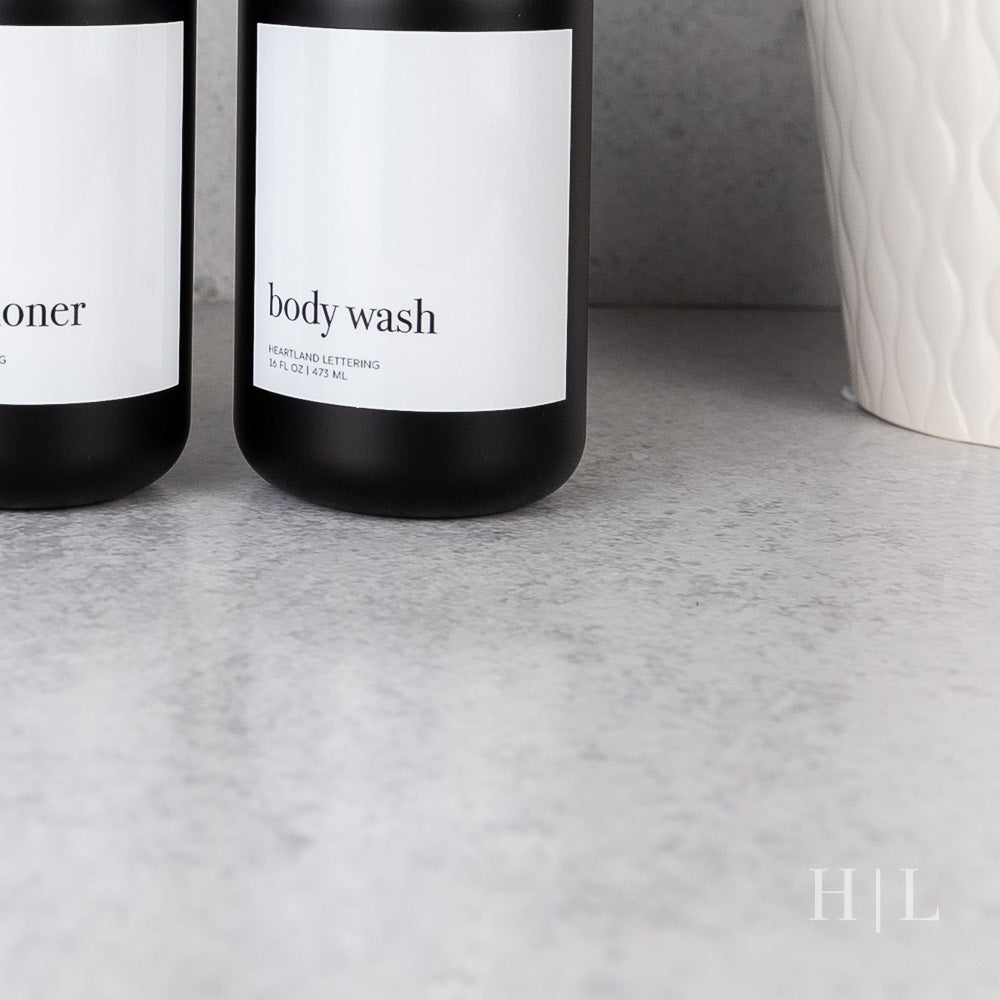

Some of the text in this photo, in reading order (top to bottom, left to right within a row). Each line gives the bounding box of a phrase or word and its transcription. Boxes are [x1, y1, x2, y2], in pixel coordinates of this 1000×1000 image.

[268, 281, 438, 339] body wash
[268, 343, 381, 370] HEARTLAND LETTERING
[269, 357, 278, 368] 16
[279, 360, 289, 372] FL
[290, 362, 304, 375] OZ
[311, 367, 330, 379] 473
[332, 369, 349, 381] ML
